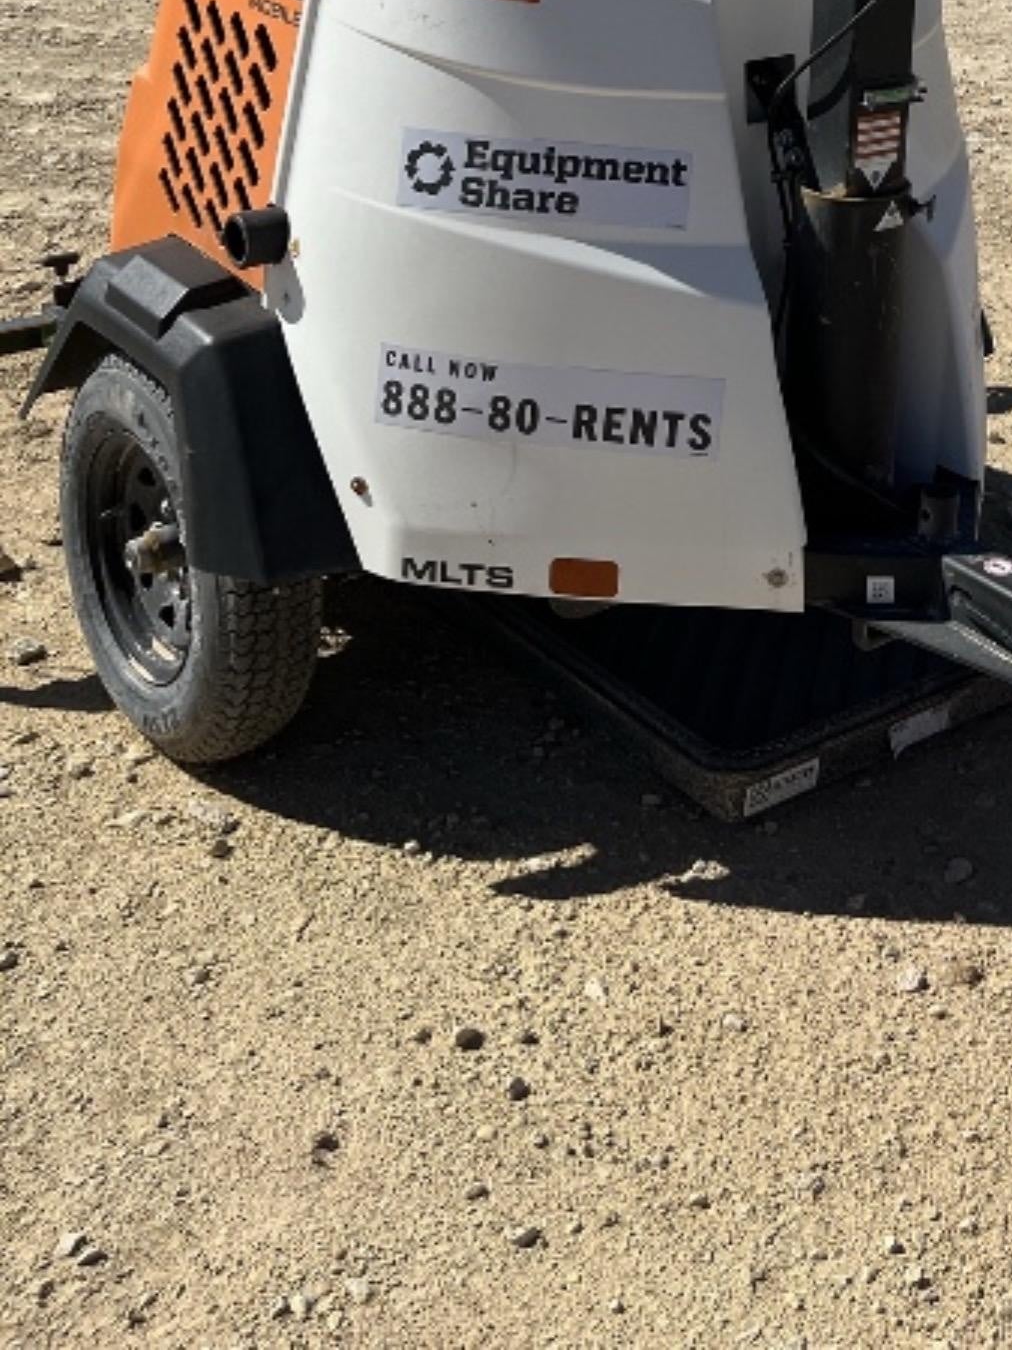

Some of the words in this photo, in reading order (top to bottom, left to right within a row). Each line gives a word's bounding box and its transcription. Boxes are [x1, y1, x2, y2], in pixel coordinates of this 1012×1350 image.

[463, 139, 688, 187] Equipment
[458, 176, 580, 214] Share
[385, 350, 435, 374] CALL
[449, 359, 498, 382] NOW
[381, 380, 713, 452] 888-80-RENTS
[401, 557, 514, 589] MLTS
